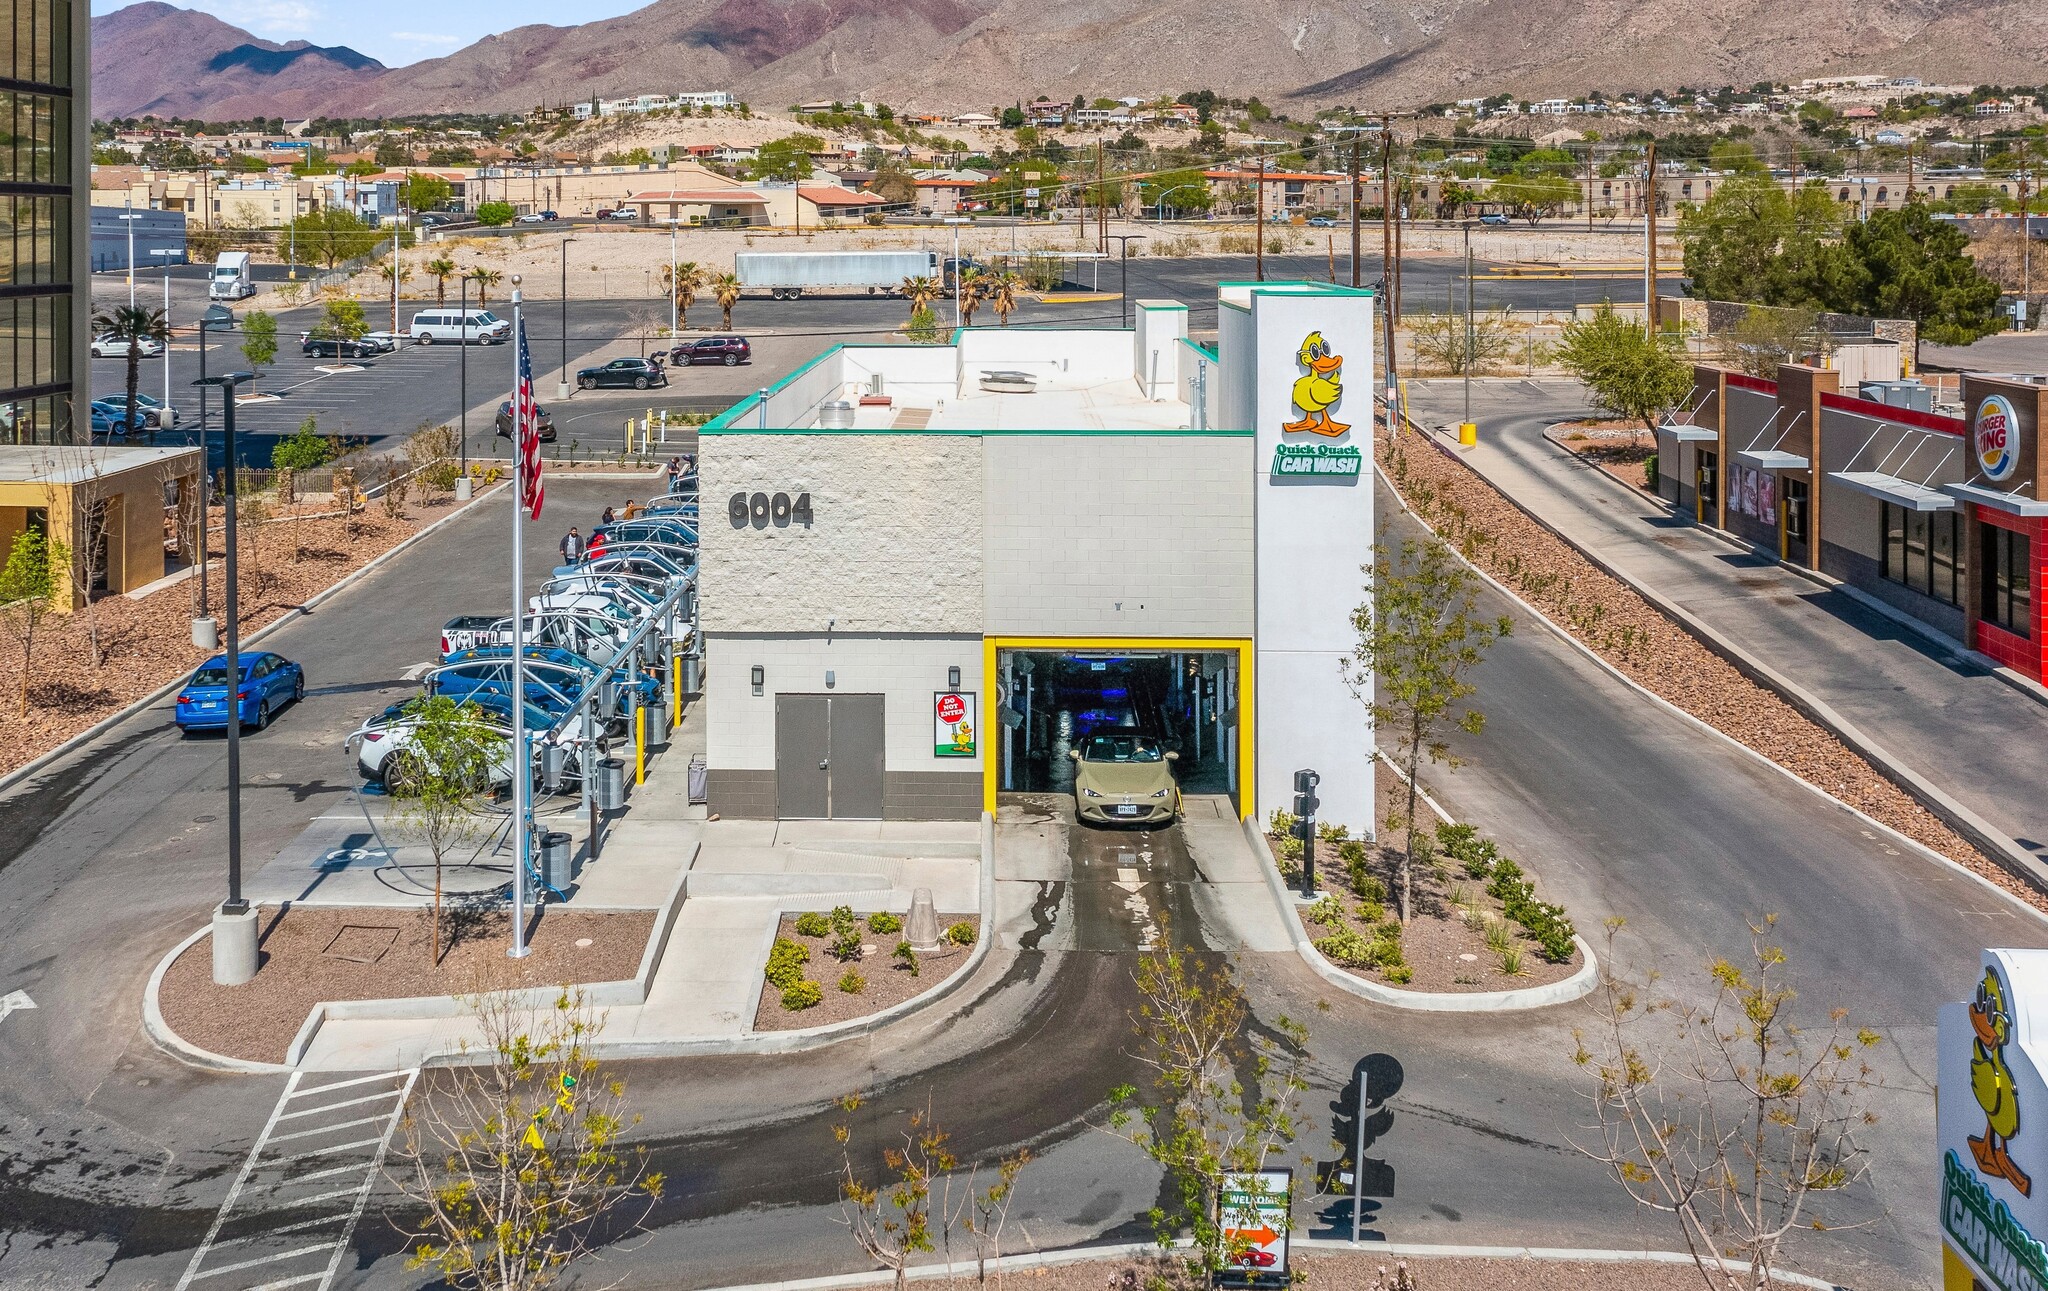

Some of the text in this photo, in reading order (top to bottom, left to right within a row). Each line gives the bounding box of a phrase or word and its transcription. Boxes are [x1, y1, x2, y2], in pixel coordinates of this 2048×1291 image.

[1977, 415, 2006, 434] BURGER
[1276, 443, 1360, 457] Quick Quack
[1977, 428, 2007, 455] KING
[1280, 456, 1359, 474] CAR WASH
[728, 491, 814, 523] 6004
[943, 703, 959, 711] NOT
[944, 697, 955, 705] DO
[940, 709, 965, 718] ENTER
[1944, 1151, 1993, 1221] Quick
[1950, 1194, 1988, 1265] CAR
